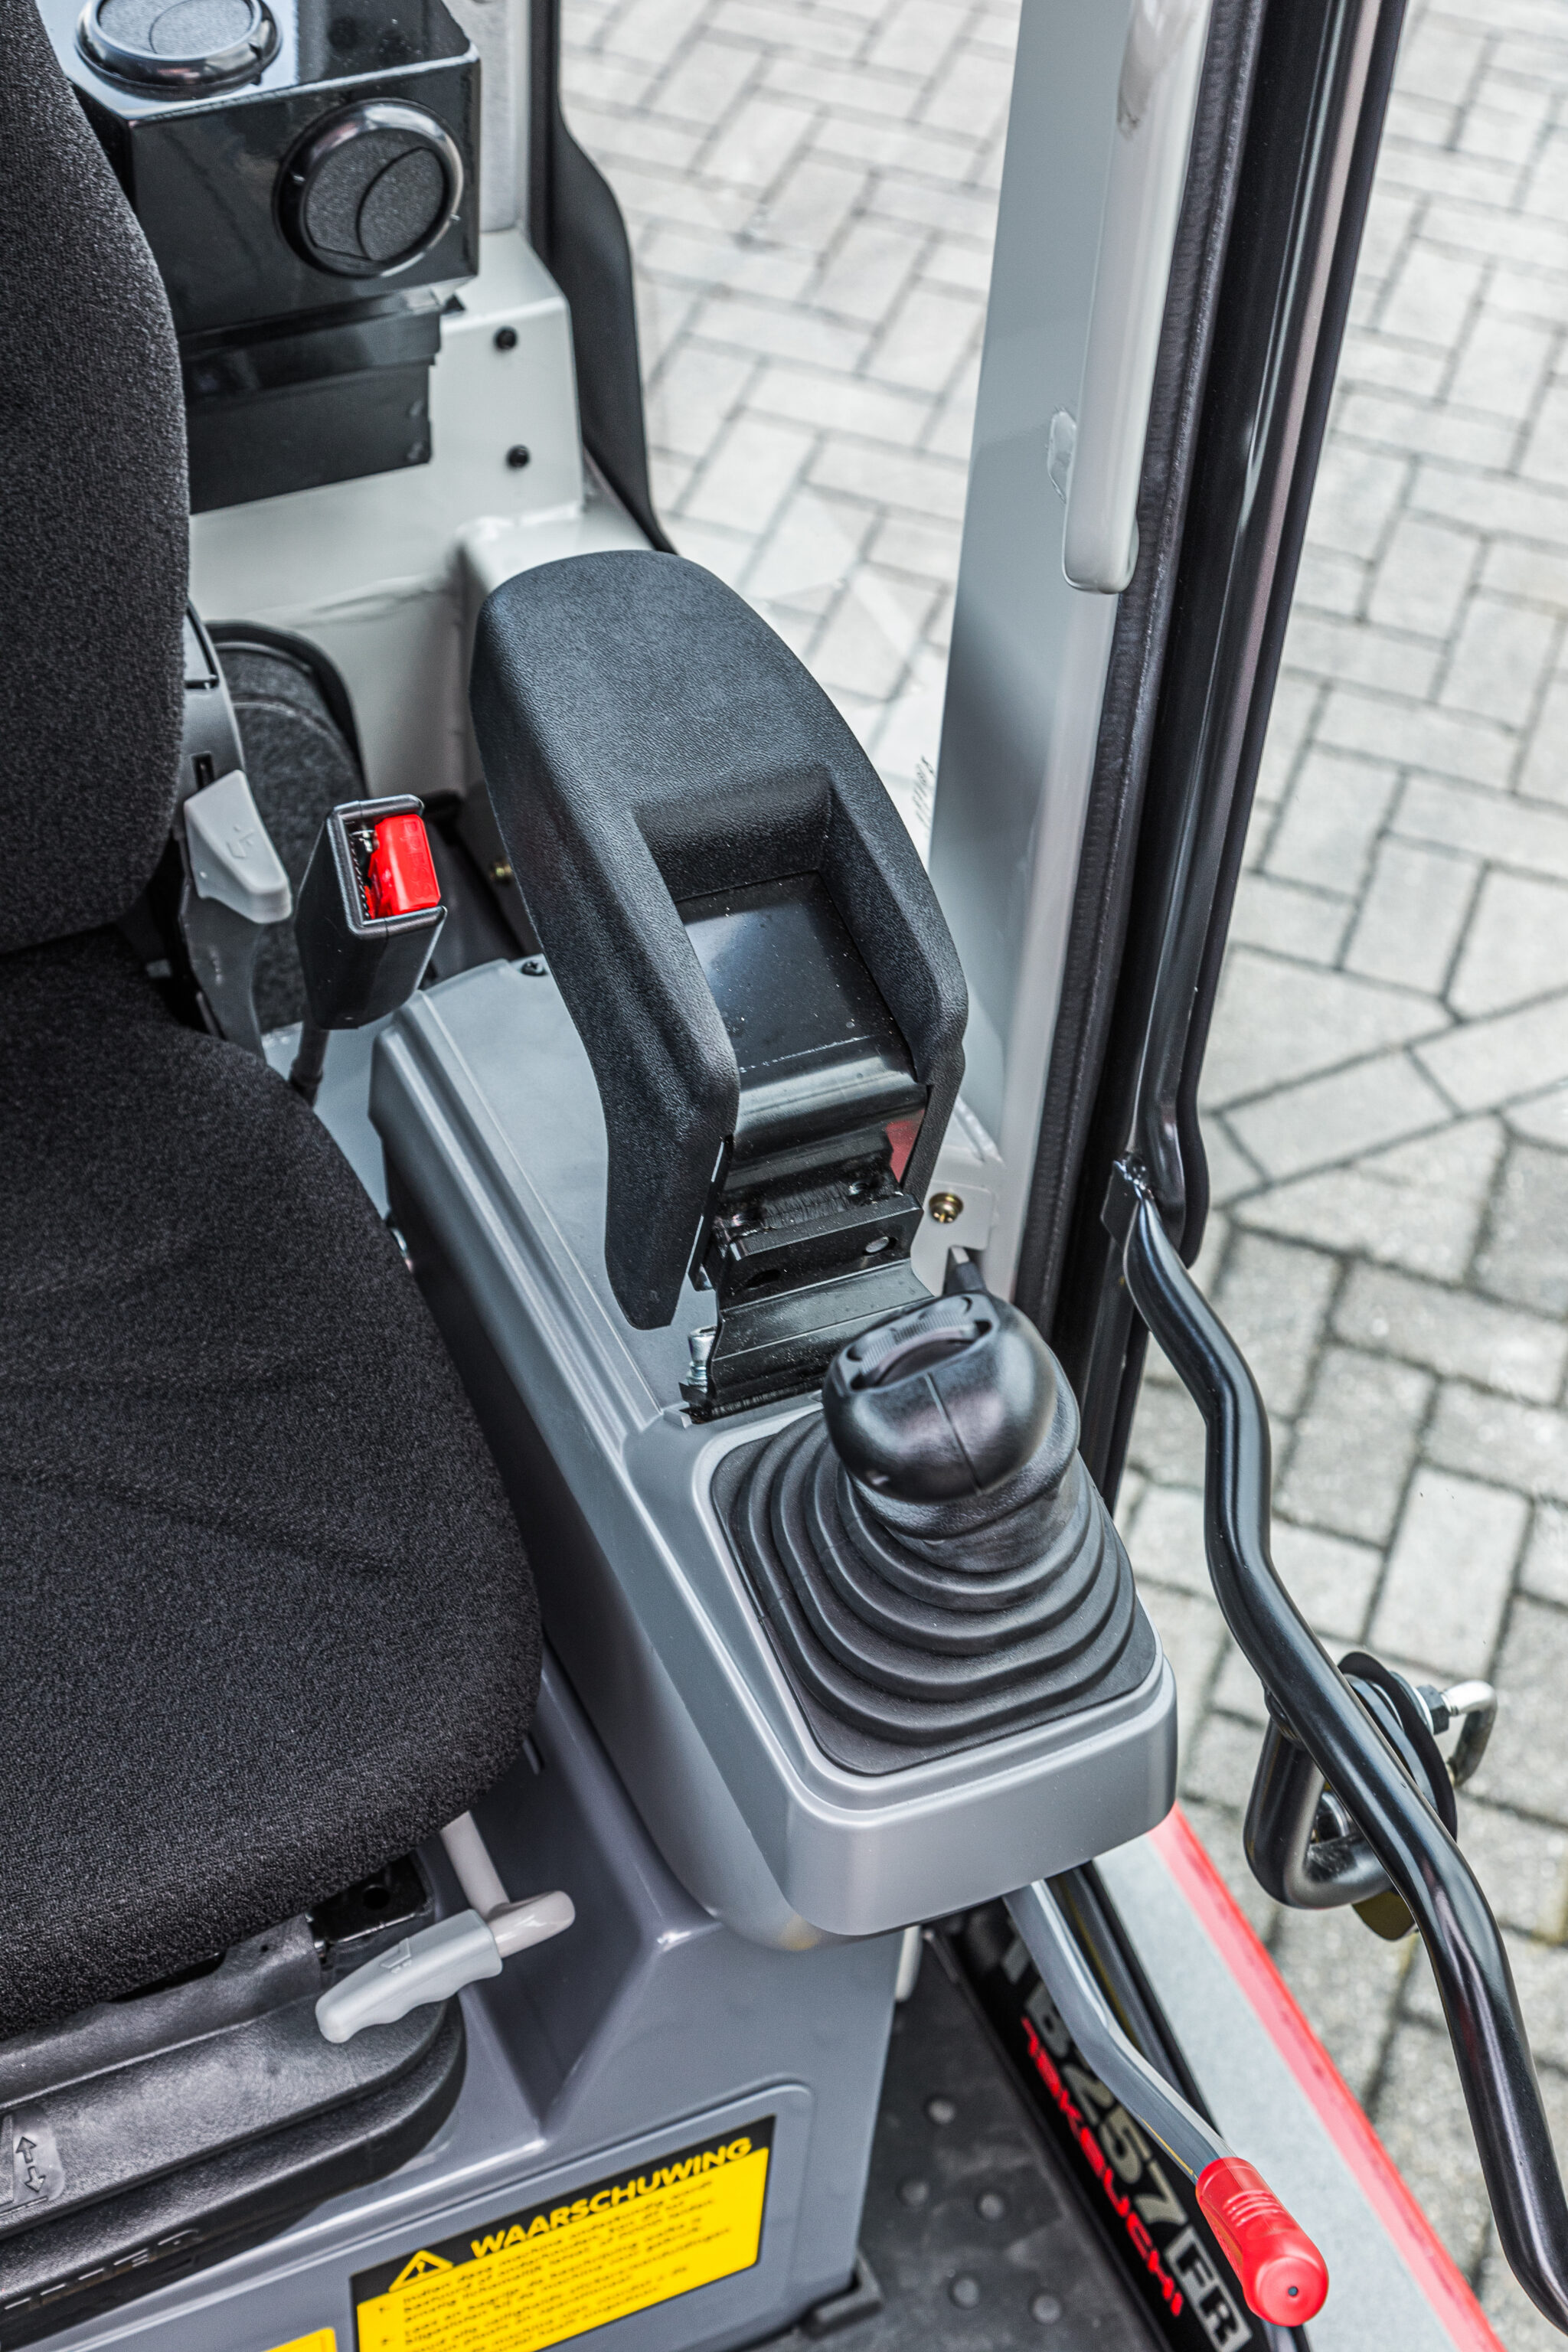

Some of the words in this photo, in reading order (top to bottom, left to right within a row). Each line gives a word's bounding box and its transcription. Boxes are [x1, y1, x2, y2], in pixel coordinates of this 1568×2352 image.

[399, 820, 435, 898] PRESS
[471, 2136, 753, 2259] WAARSCHUWING
[1021, 2015, 1184, 2318] TAKEUCHI
